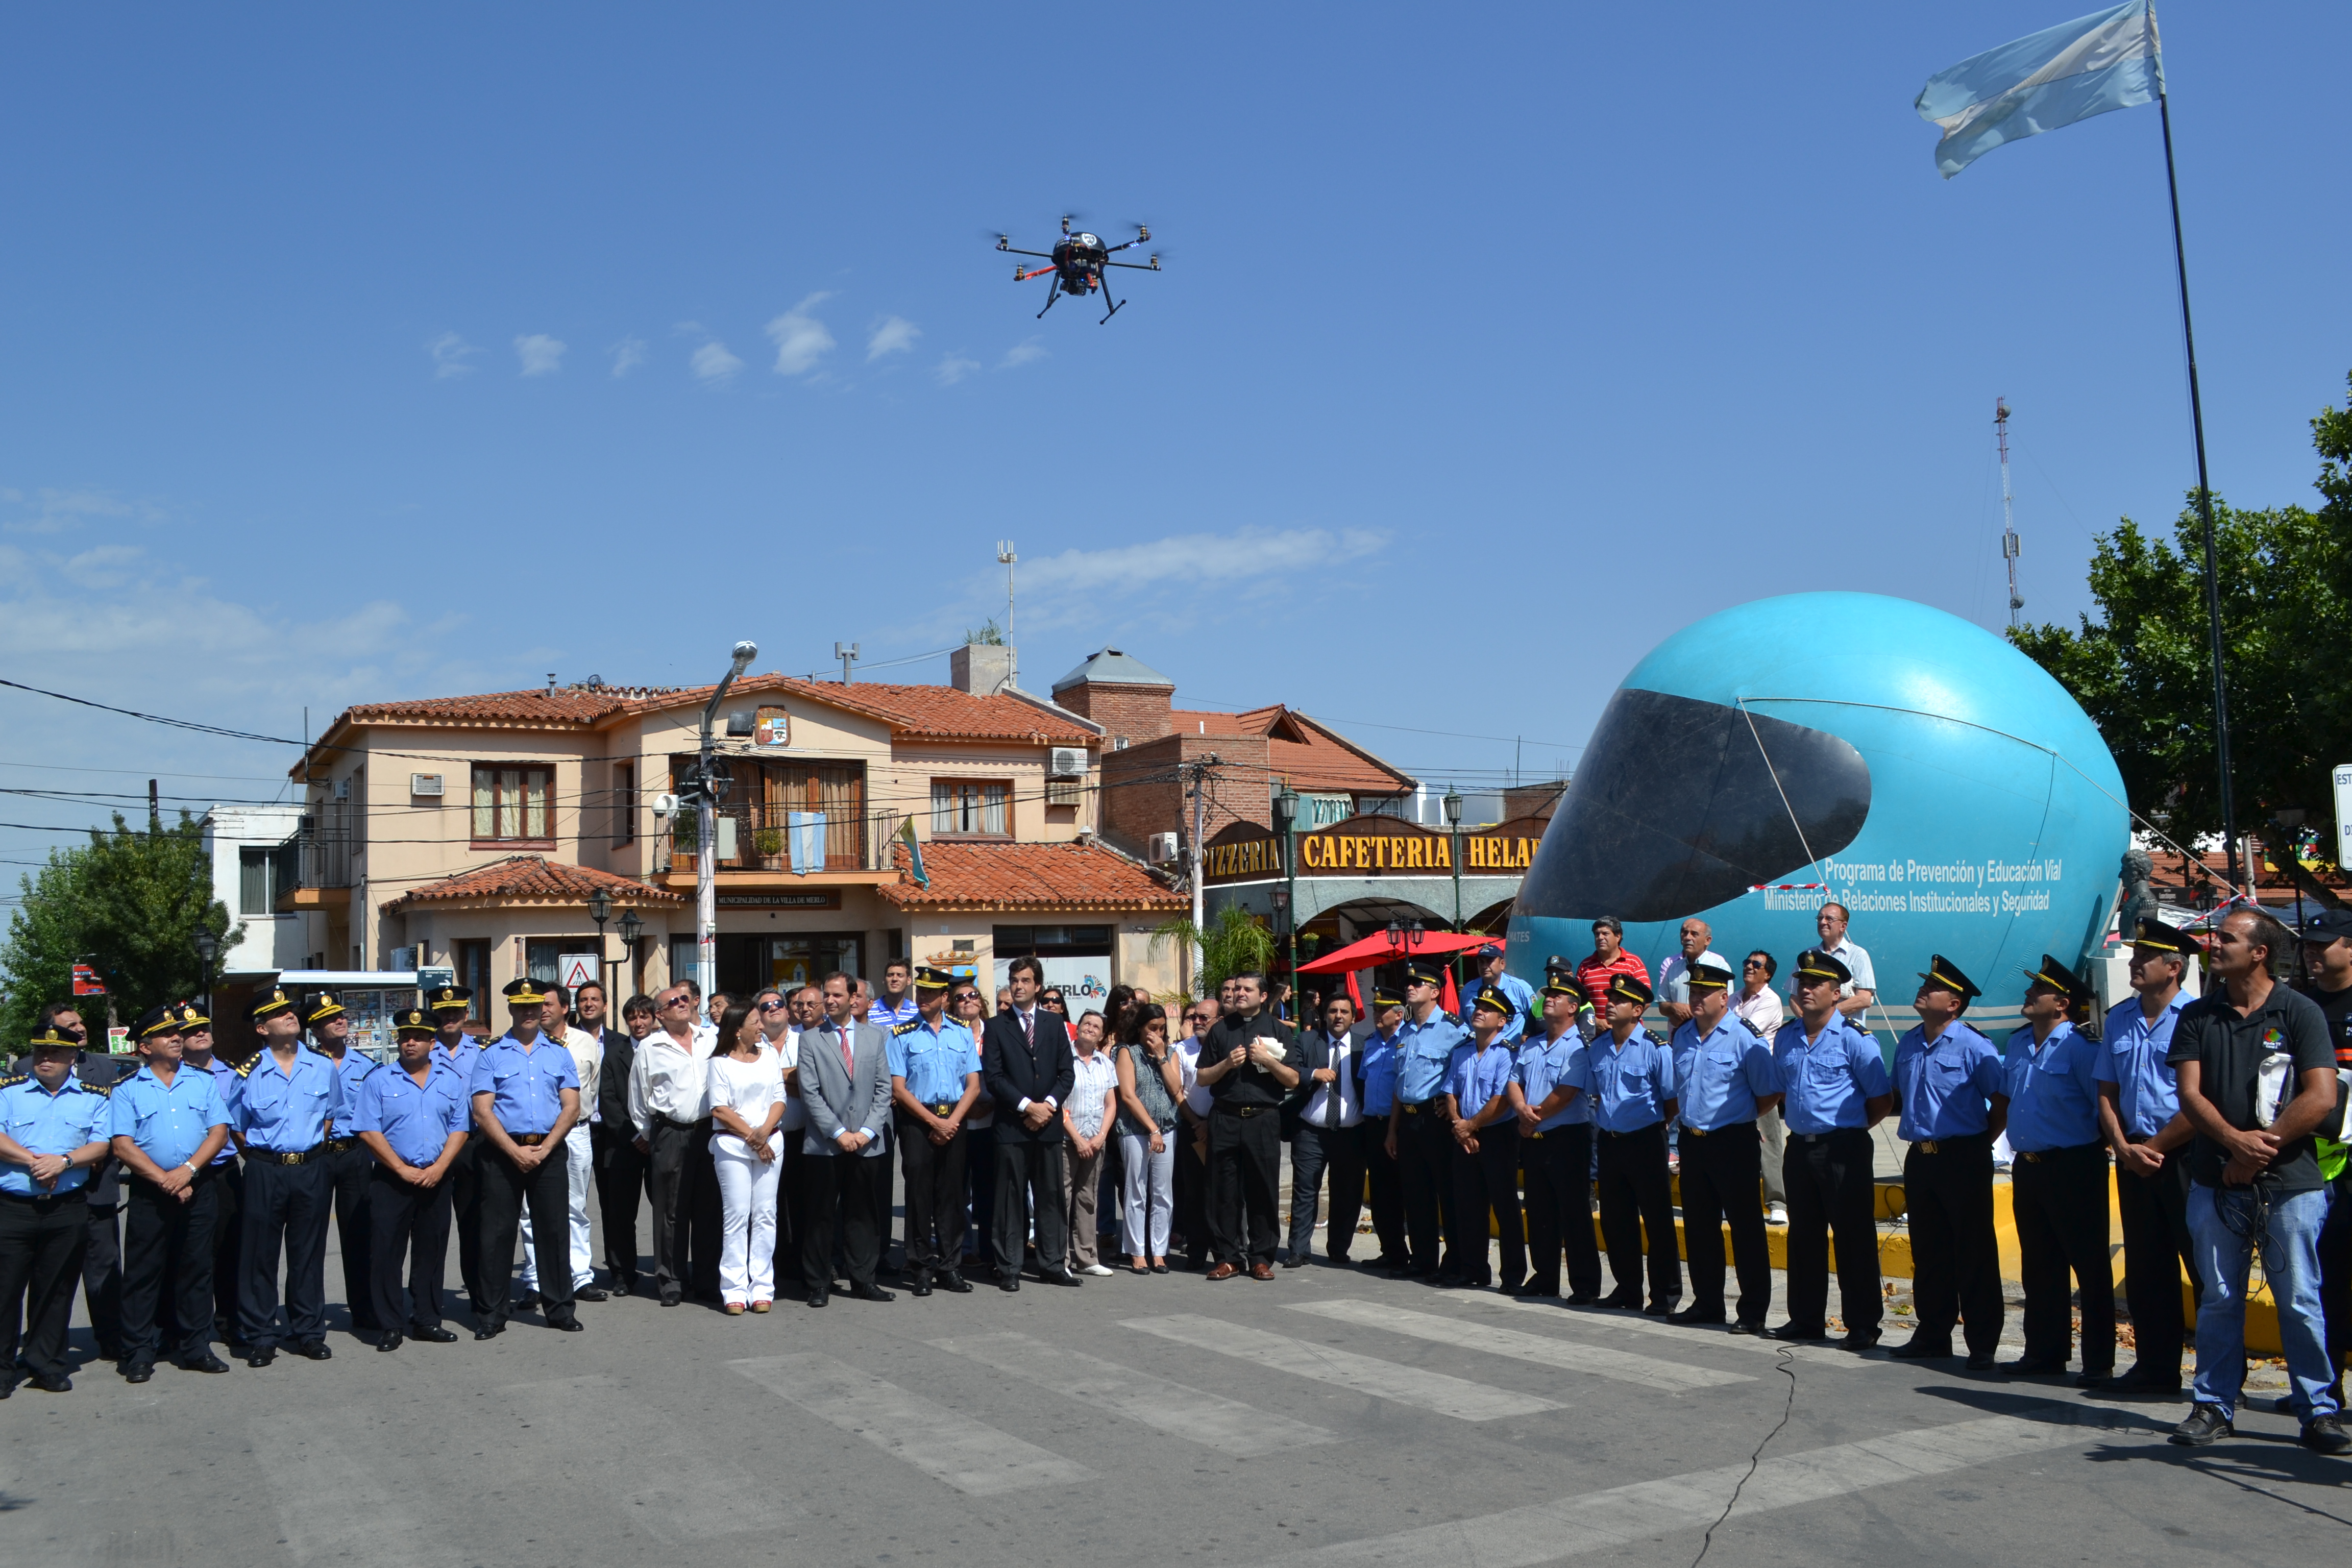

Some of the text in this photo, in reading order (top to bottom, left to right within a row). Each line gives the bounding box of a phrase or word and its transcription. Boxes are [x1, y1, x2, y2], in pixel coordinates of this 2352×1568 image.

[1304, 836, 1451, 868] CAFETERIA
[1825, 857, 2062, 888] Programa de Prevención y Educación Vial
[1764, 889, 2050, 917] Ministerio de Relaciones Institucionales y Seguridad
[1510, 931, 1530, 942] MATES
[1043, 984, 1091, 996] RLO
